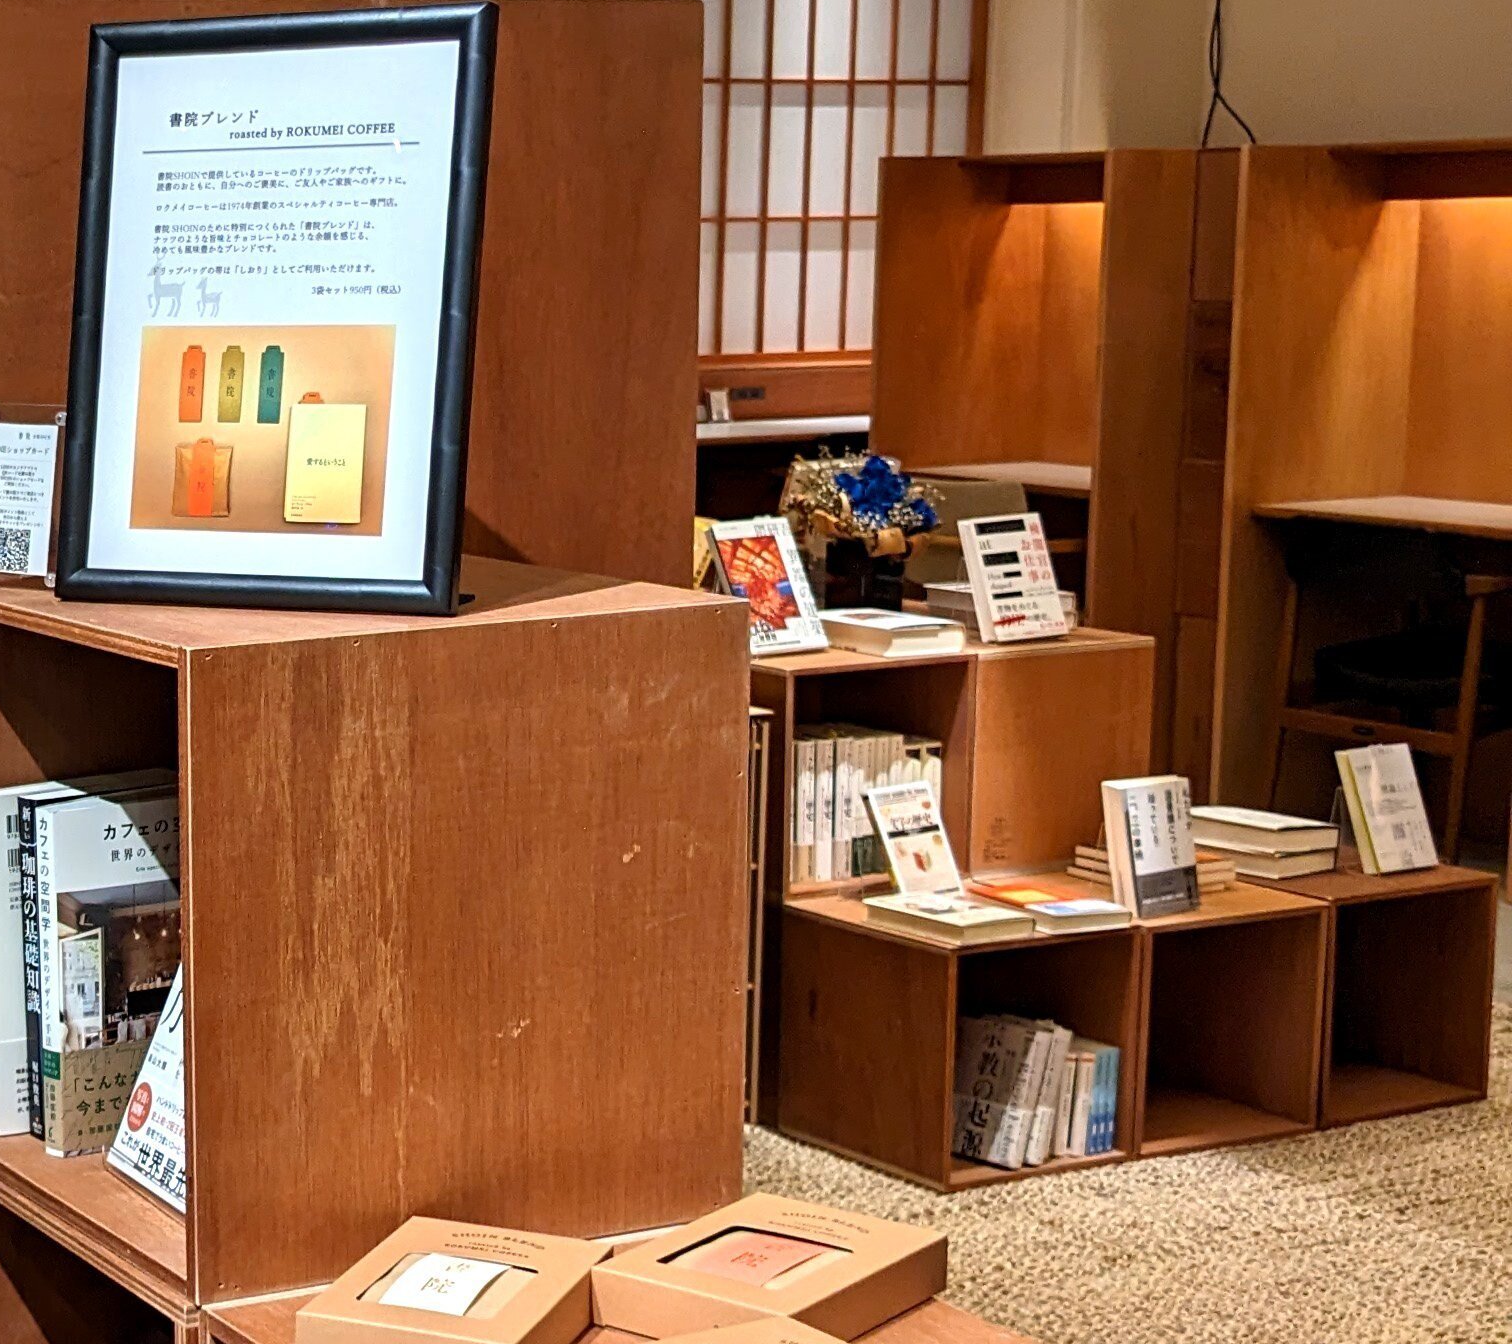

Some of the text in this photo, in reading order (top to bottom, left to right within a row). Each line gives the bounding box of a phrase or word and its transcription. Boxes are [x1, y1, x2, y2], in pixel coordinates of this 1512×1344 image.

[169, 110, 259, 128] 書院ブレンド
[229, 123, 396, 141] roasted by ROKUMEI COFFEE
[22, 807, 31, 840] 新しい
[39, 817, 51, 932] カフェの空間学
[22, 853, 41, 1014] 珈琲の基礎知識
